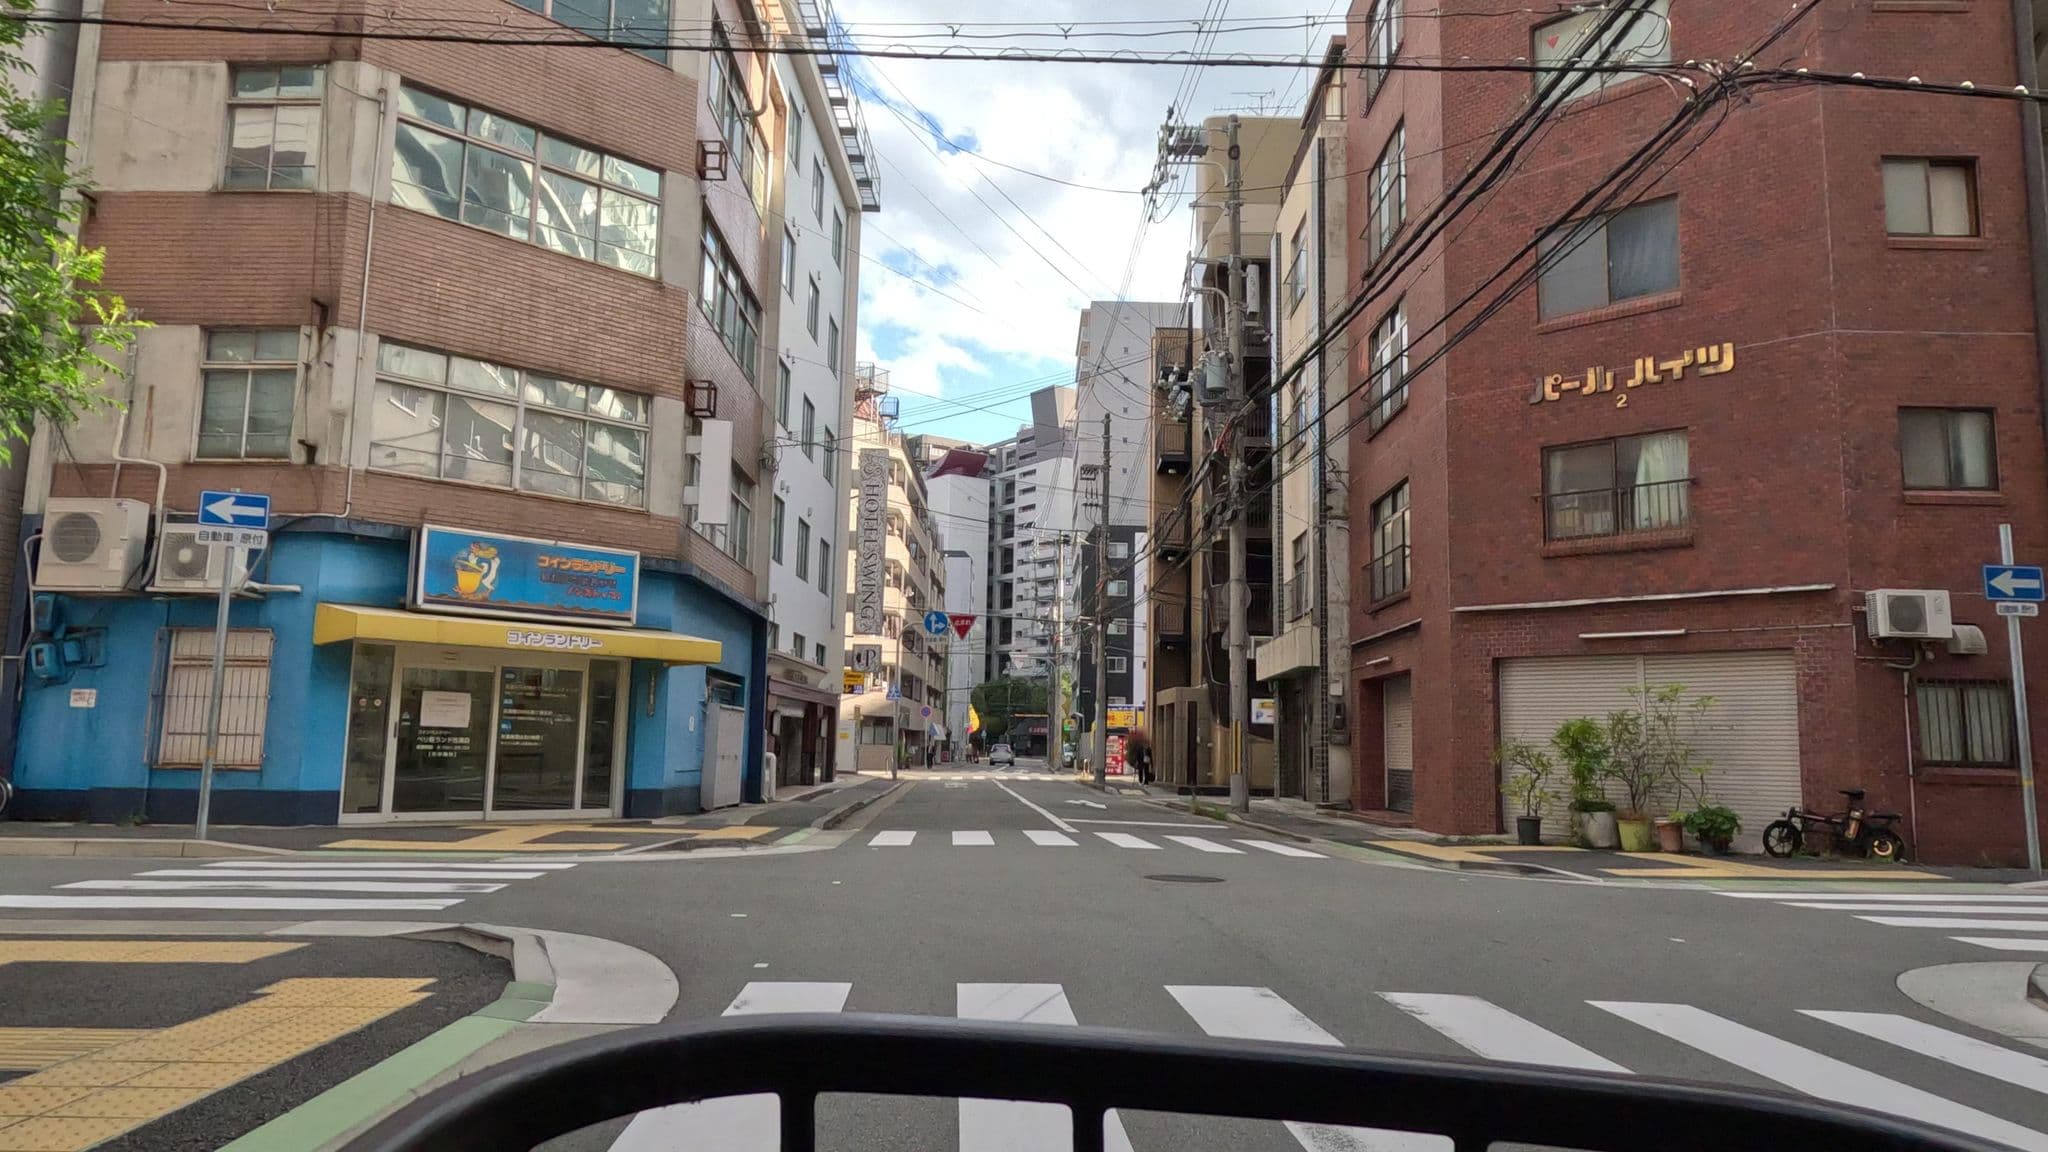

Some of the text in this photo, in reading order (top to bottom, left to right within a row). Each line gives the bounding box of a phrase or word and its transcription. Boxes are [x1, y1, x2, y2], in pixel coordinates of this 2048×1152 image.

[860, 551, 878, 620] SWING
[507, 630, 603, 650] コインランドリー
